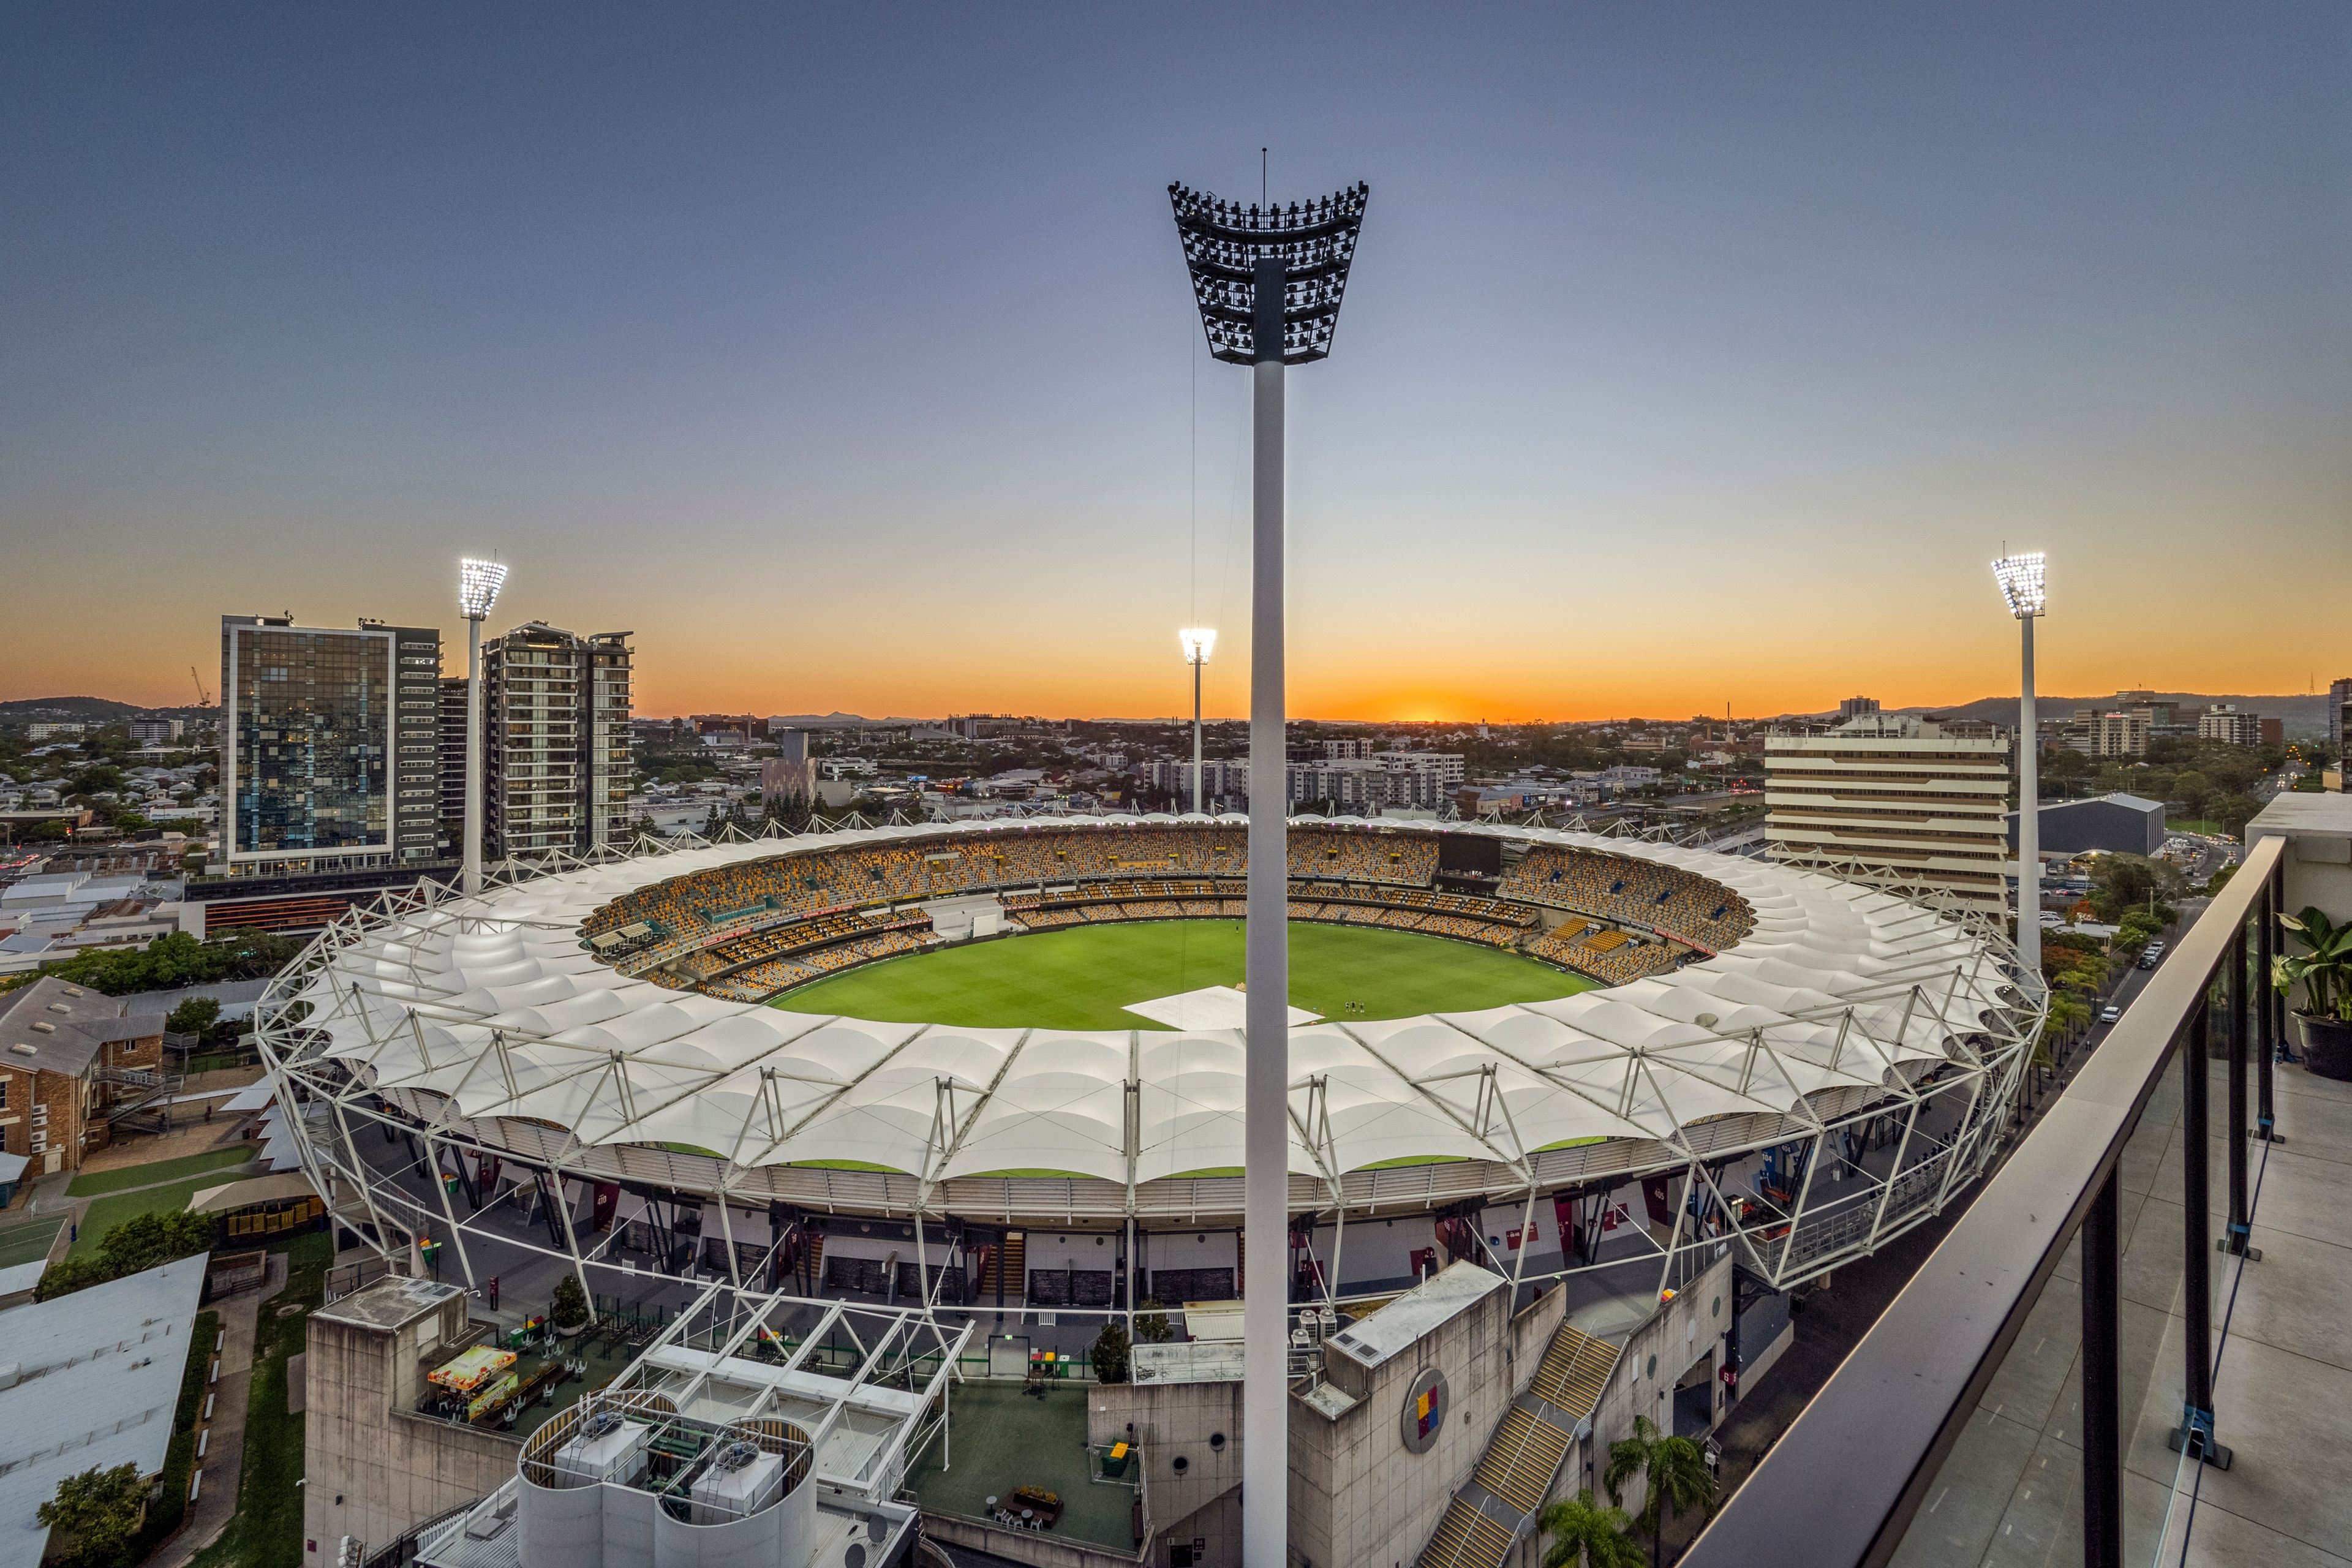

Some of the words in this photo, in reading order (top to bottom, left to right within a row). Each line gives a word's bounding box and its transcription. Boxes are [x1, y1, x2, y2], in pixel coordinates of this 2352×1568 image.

[1654, 1189, 1665, 1200] 405
[597, 1195, 607, 1205] 410
[1724, 1372, 1729, 1382] 6
